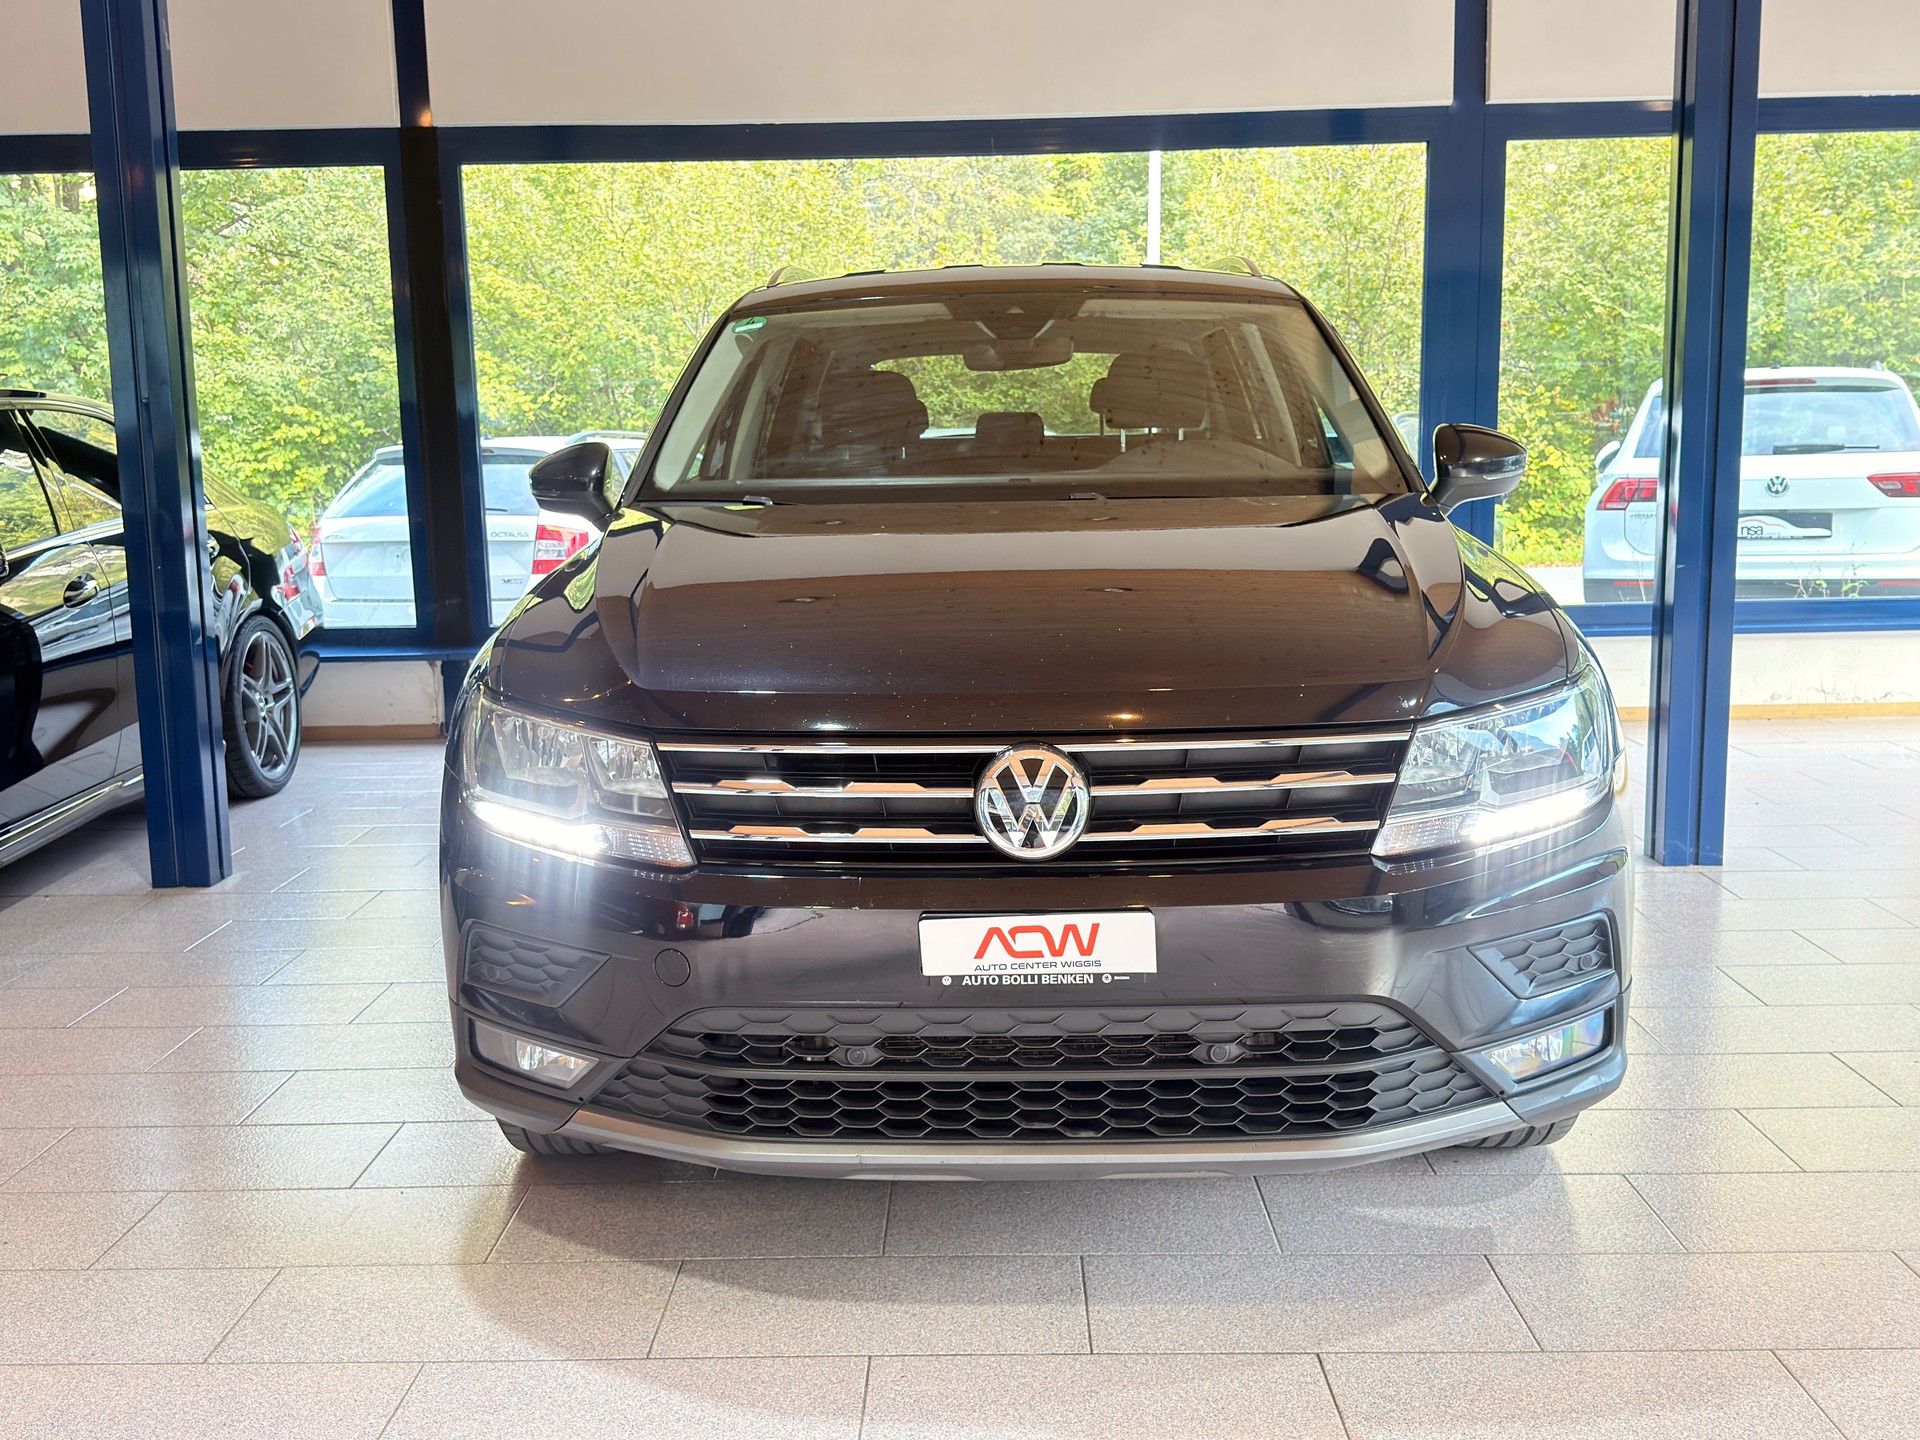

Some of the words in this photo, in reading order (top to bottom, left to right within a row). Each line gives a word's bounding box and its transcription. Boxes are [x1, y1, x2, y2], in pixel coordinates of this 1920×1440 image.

[1740, 525, 1764, 536] nsa
[979, 747, 1087, 858] VW
[973, 923, 1100, 959] ACW
[974, 963, 1008, 972] AUTO
[1010, 961, 1058, 970] CENTER
[1060, 959, 1102, 969] WIGGIS
[961, 975, 1000, 986] AUTO
[1002, 974, 1038, 986] BOLLI
[1041, 973, 1094, 985] BENKEN
